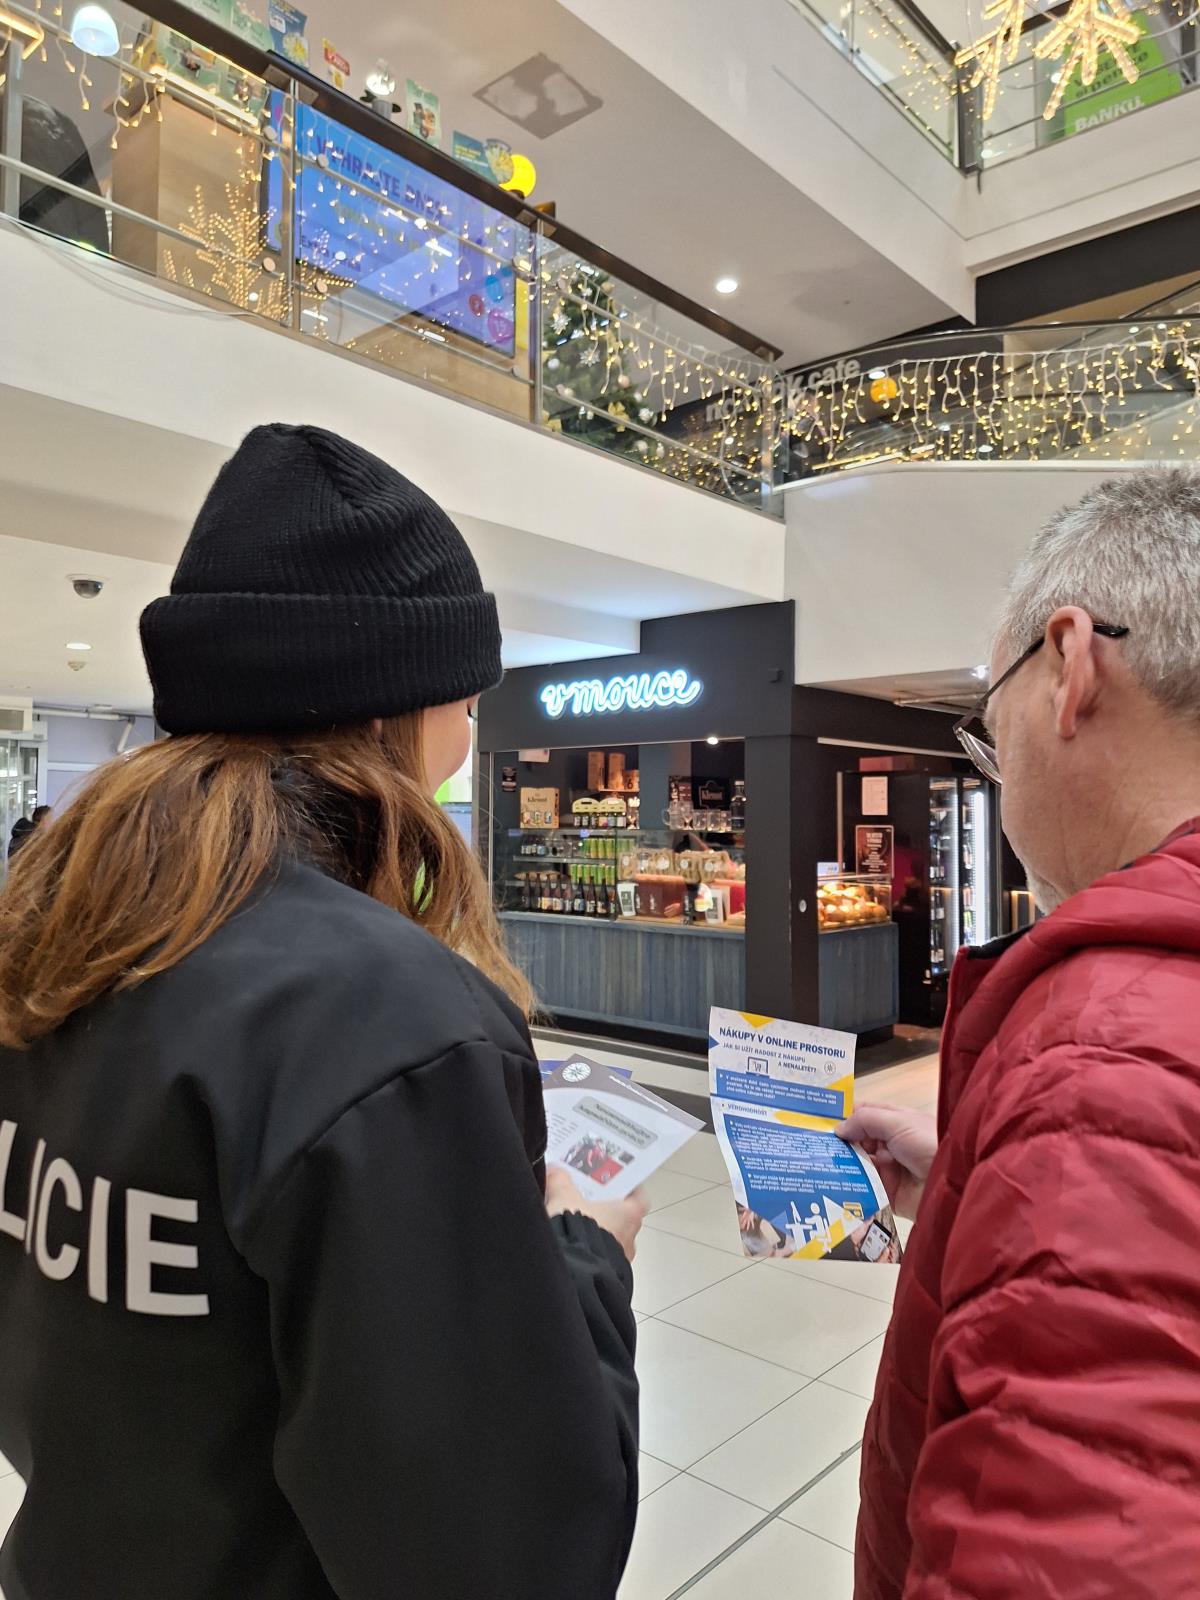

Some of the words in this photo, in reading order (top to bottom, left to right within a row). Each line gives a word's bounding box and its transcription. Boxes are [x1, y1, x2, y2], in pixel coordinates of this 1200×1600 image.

[808, 358, 861, 391] cafe
[719, 1026, 756, 1042] NÁKUPY
[758, 1034, 764, 1044] V
[765, 1036, 798, 1051] ONLINE
[799, 1042, 846, 1059] PROSTORU
[723, 1042, 734, 1050] JAK
[754, 1047, 777, 1058] RADOST
